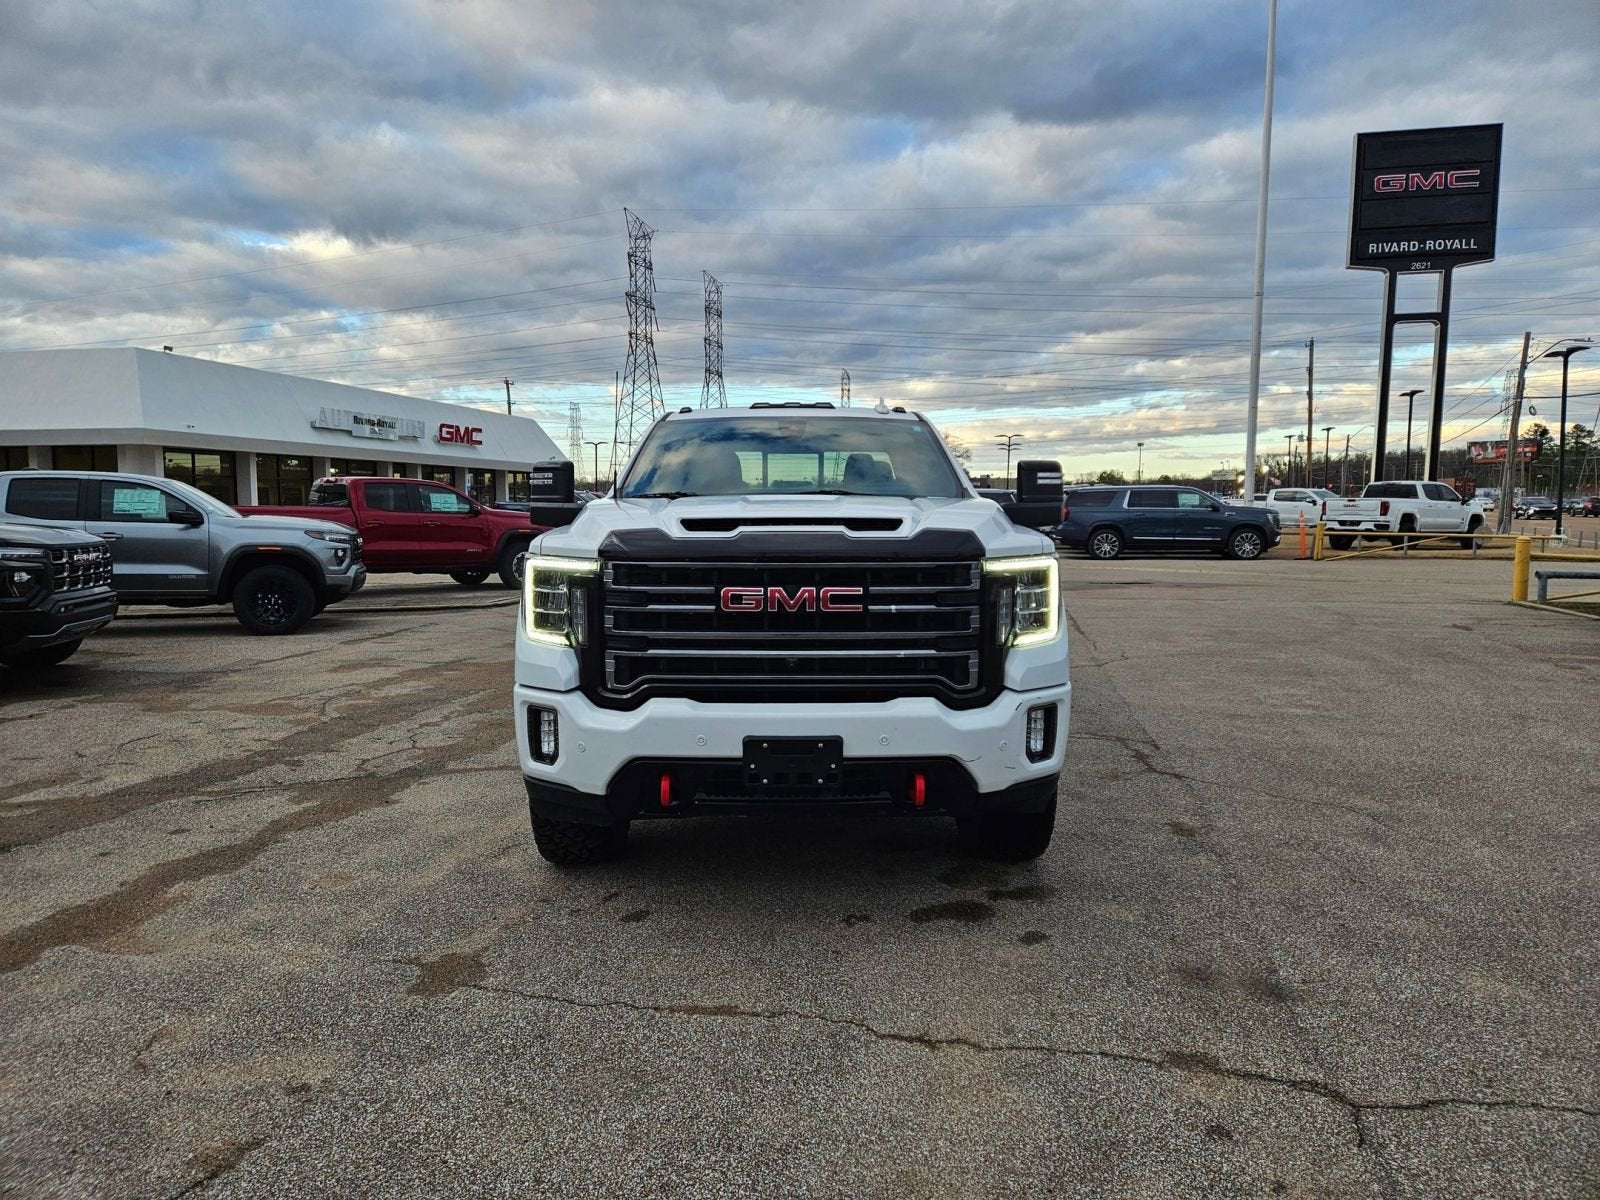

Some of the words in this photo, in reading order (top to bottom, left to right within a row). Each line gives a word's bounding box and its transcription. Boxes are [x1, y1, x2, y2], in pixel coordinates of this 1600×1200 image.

[1374, 169, 1481, 193] GMC
[1368, 238, 1478, 254] RIVARD-ROYALL
[1411, 261, 1431, 270] 2621
[439, 423, 483, 446] GMC
[720, 587, 864, 612] GMC
